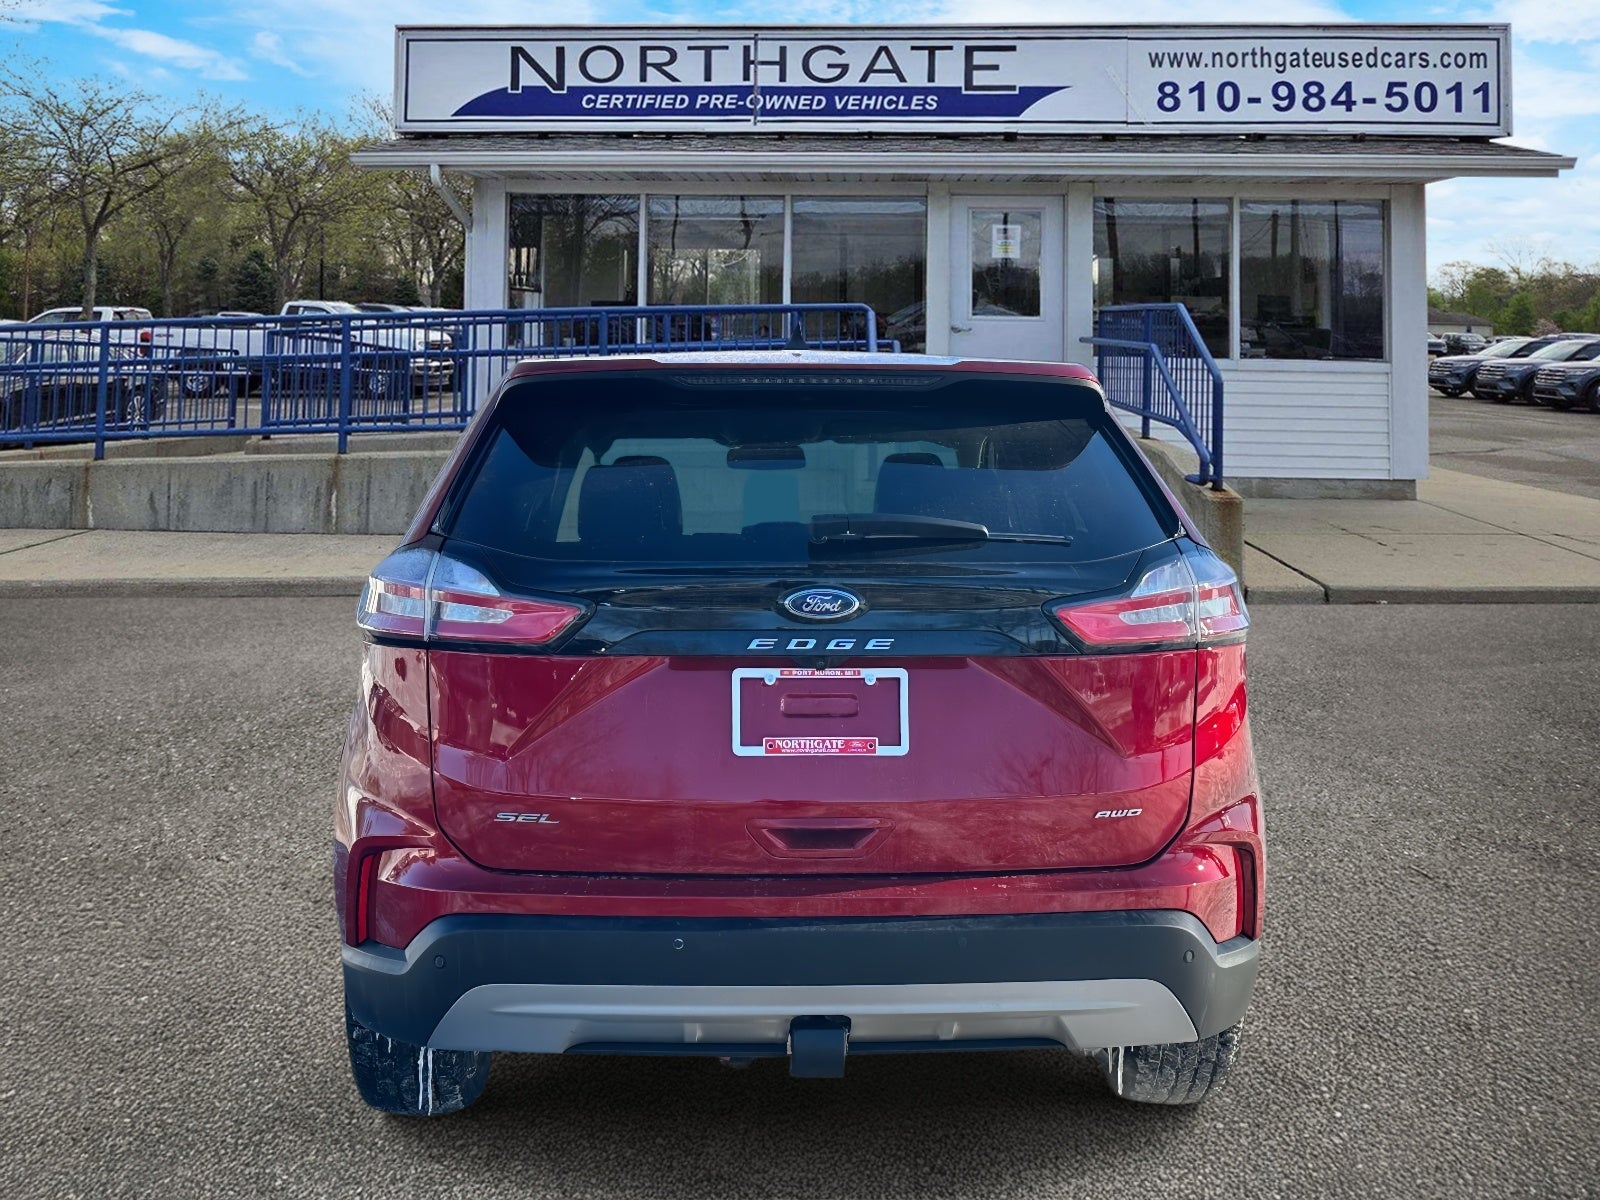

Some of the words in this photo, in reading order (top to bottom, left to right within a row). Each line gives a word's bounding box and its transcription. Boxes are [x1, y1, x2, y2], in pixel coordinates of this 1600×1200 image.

[509, 44, 1018, 92] NORTHGATE
[1148, 46, 1489, 74] www.northgateusedcars.com
[581, 93, 690, 110] CERTIFIED
[695, 93, 827, 111] PRE-OWNED
[834, 94, 939, 111] VEHICLES
[1156, 80, 1492, 114] 810-984-5011
[802, 594, 842, 612] Ford
[747, 638, 895, 650] EDGE
[775, 739, 845, 749] NORTHGATE
[493, 812, 560, 824] SEL
[1094, 808, 1143, 819] AWD
